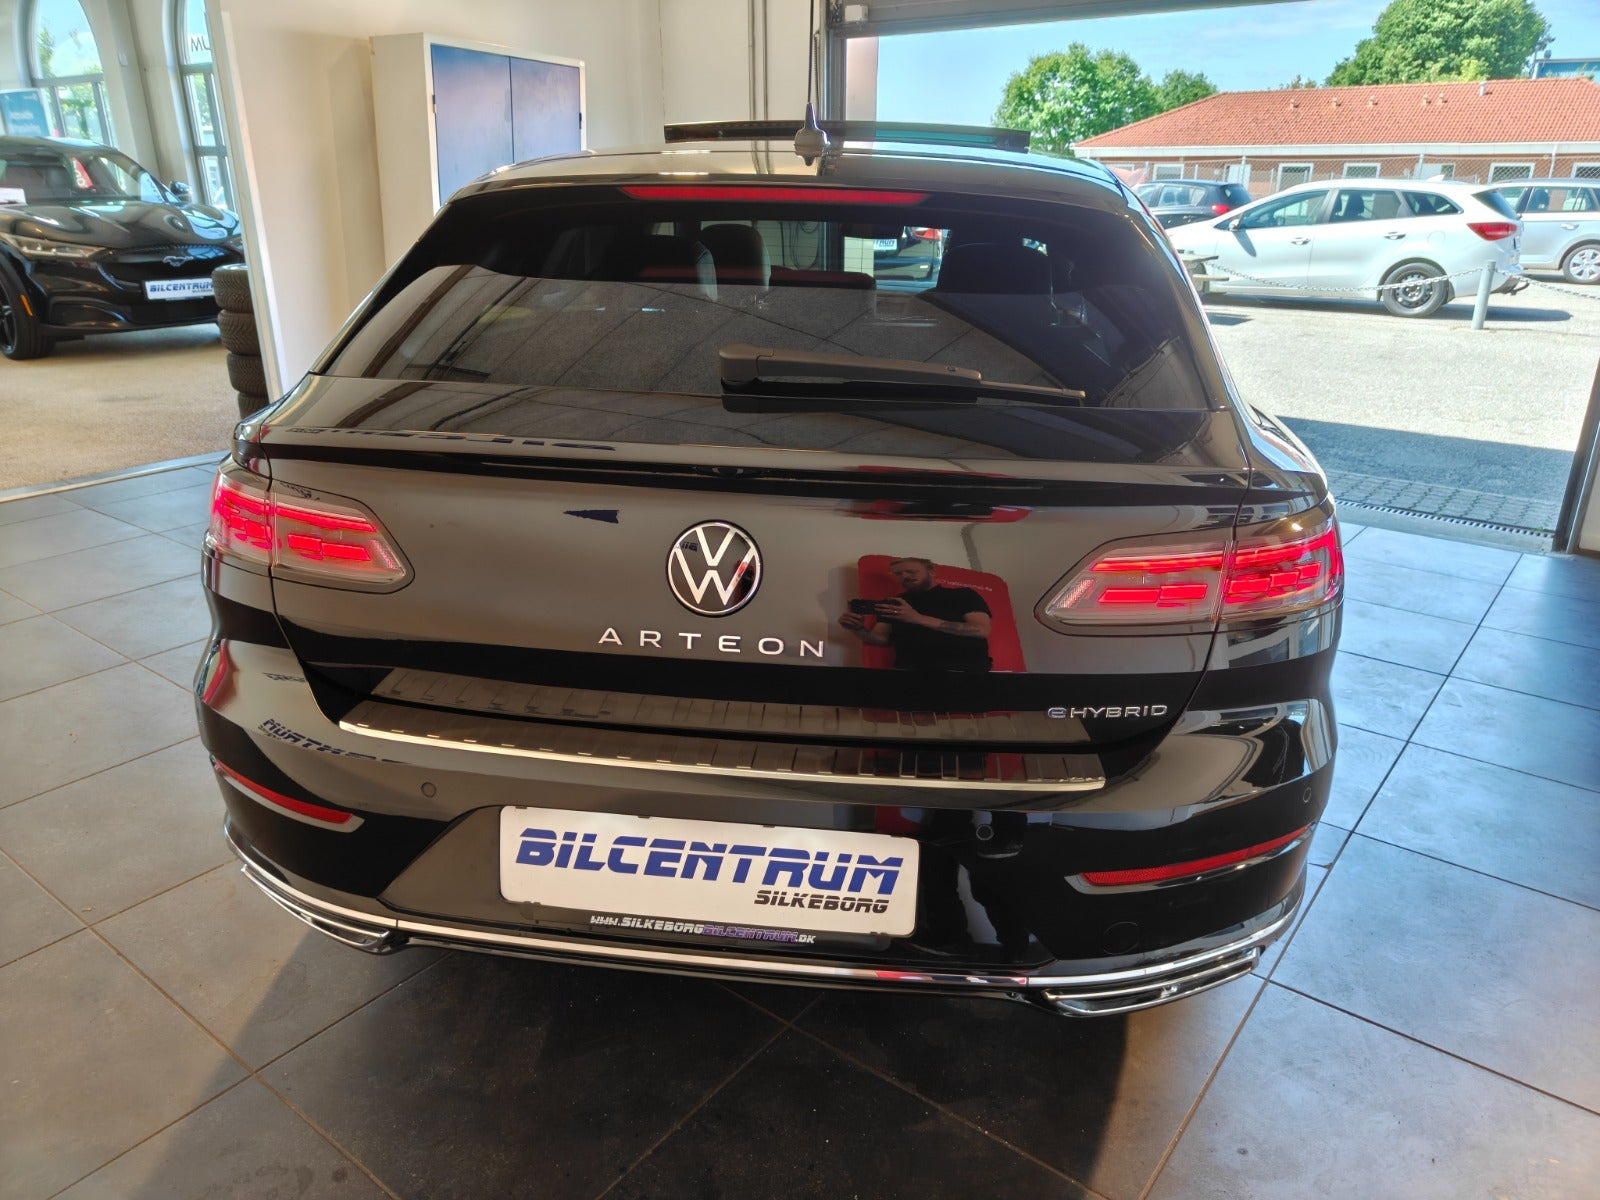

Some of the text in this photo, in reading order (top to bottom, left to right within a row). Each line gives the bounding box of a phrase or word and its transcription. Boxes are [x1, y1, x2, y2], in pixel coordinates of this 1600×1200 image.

[597, 627, 825, 658] ARTEON
[515, 827, 905, 896] BILCENTRUM
[753, 889, 891, 915] SILKEBORG
